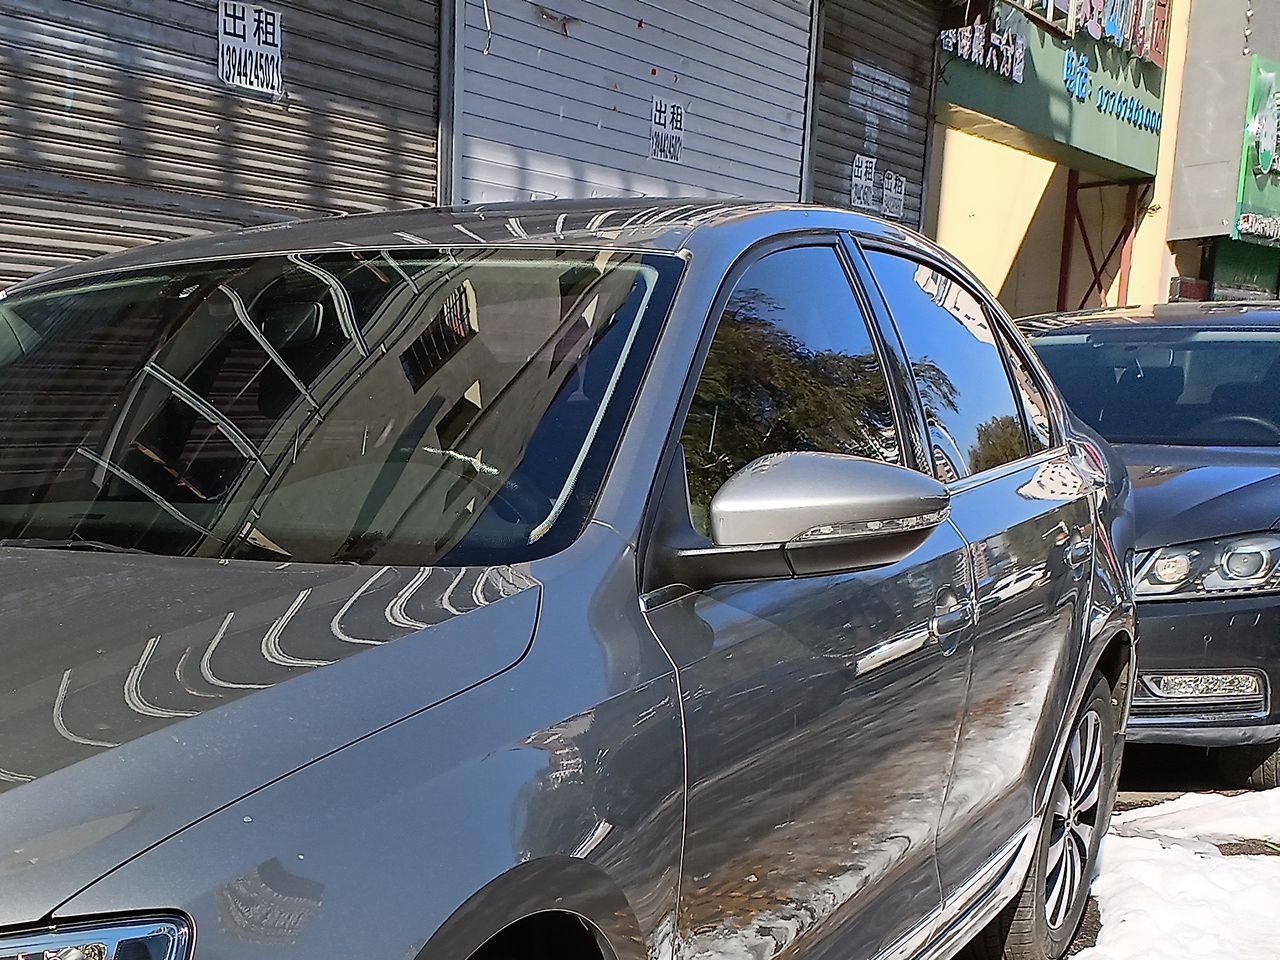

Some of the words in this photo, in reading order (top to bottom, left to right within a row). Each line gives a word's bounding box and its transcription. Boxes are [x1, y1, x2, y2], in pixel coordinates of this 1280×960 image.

[223, 2, 279, 48] 出租
[220, 43, 281, 94] 13944245021
[654, 100, 683, 131] 出租
[854, 157, 873, 181] 出租
[884, 173, 903, 194] 出租
